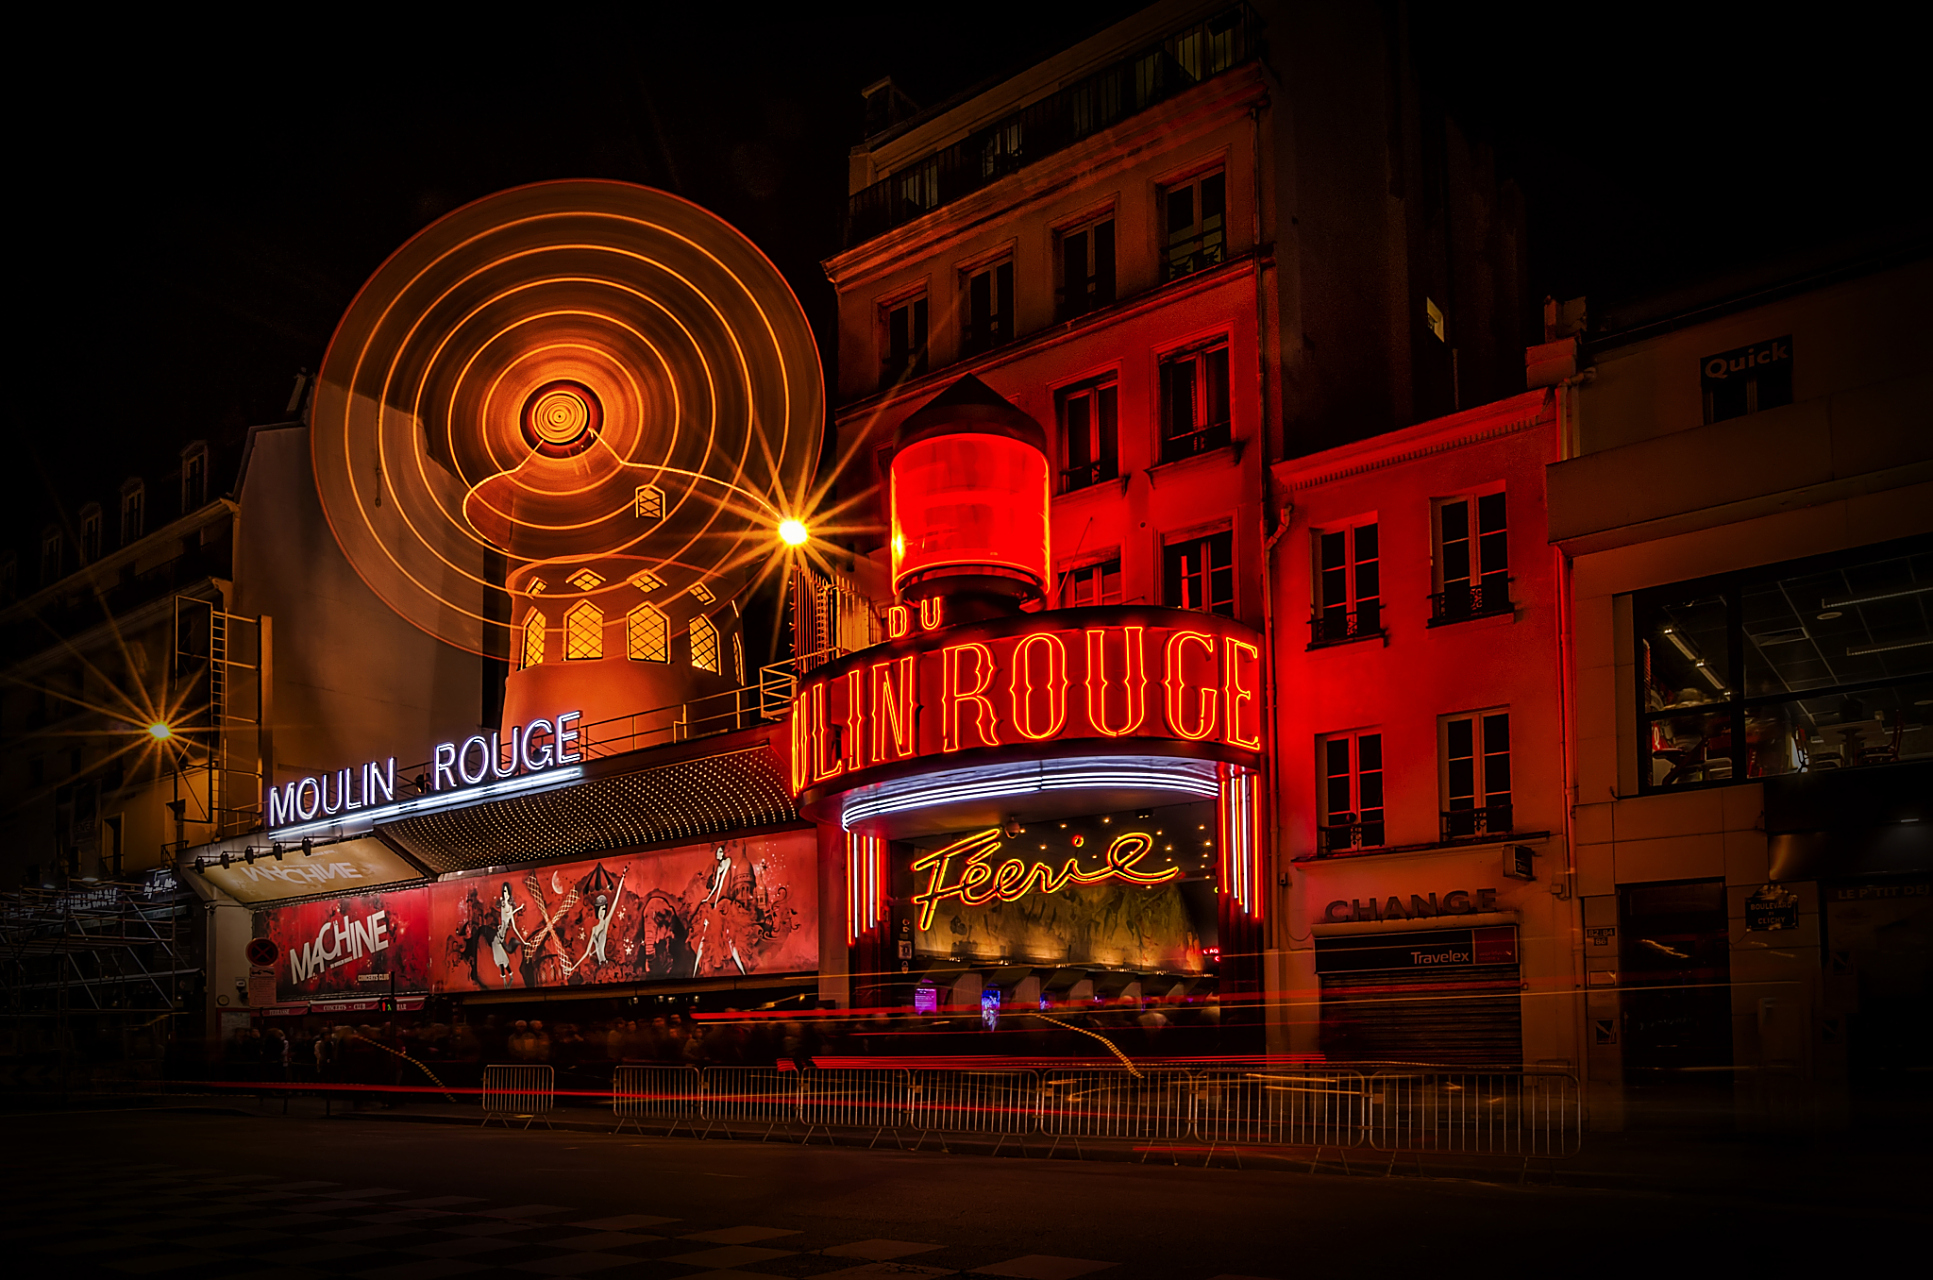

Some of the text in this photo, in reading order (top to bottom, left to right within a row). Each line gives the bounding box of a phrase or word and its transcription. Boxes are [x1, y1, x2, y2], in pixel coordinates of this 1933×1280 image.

[1704, 341, 1789, 379] Quick
[888, 597, 941, 638] DU
[942, 626, 1261, 753] ROUGE
[267, 710, 583, 827] MOULIN ROUGE
[911, 828, 1179, 931] Féerie
[1837, 889, 1855, 900] LE
[1324, 888, 1497, 922] CHANGE
[1750, 902, 1792, 910] BOULEVARD
[1757, 916, 1786, 925] CLICHY
[289, 909, 389, 985] MACHINE
[1410, 950, 1471, 965] Travelex
